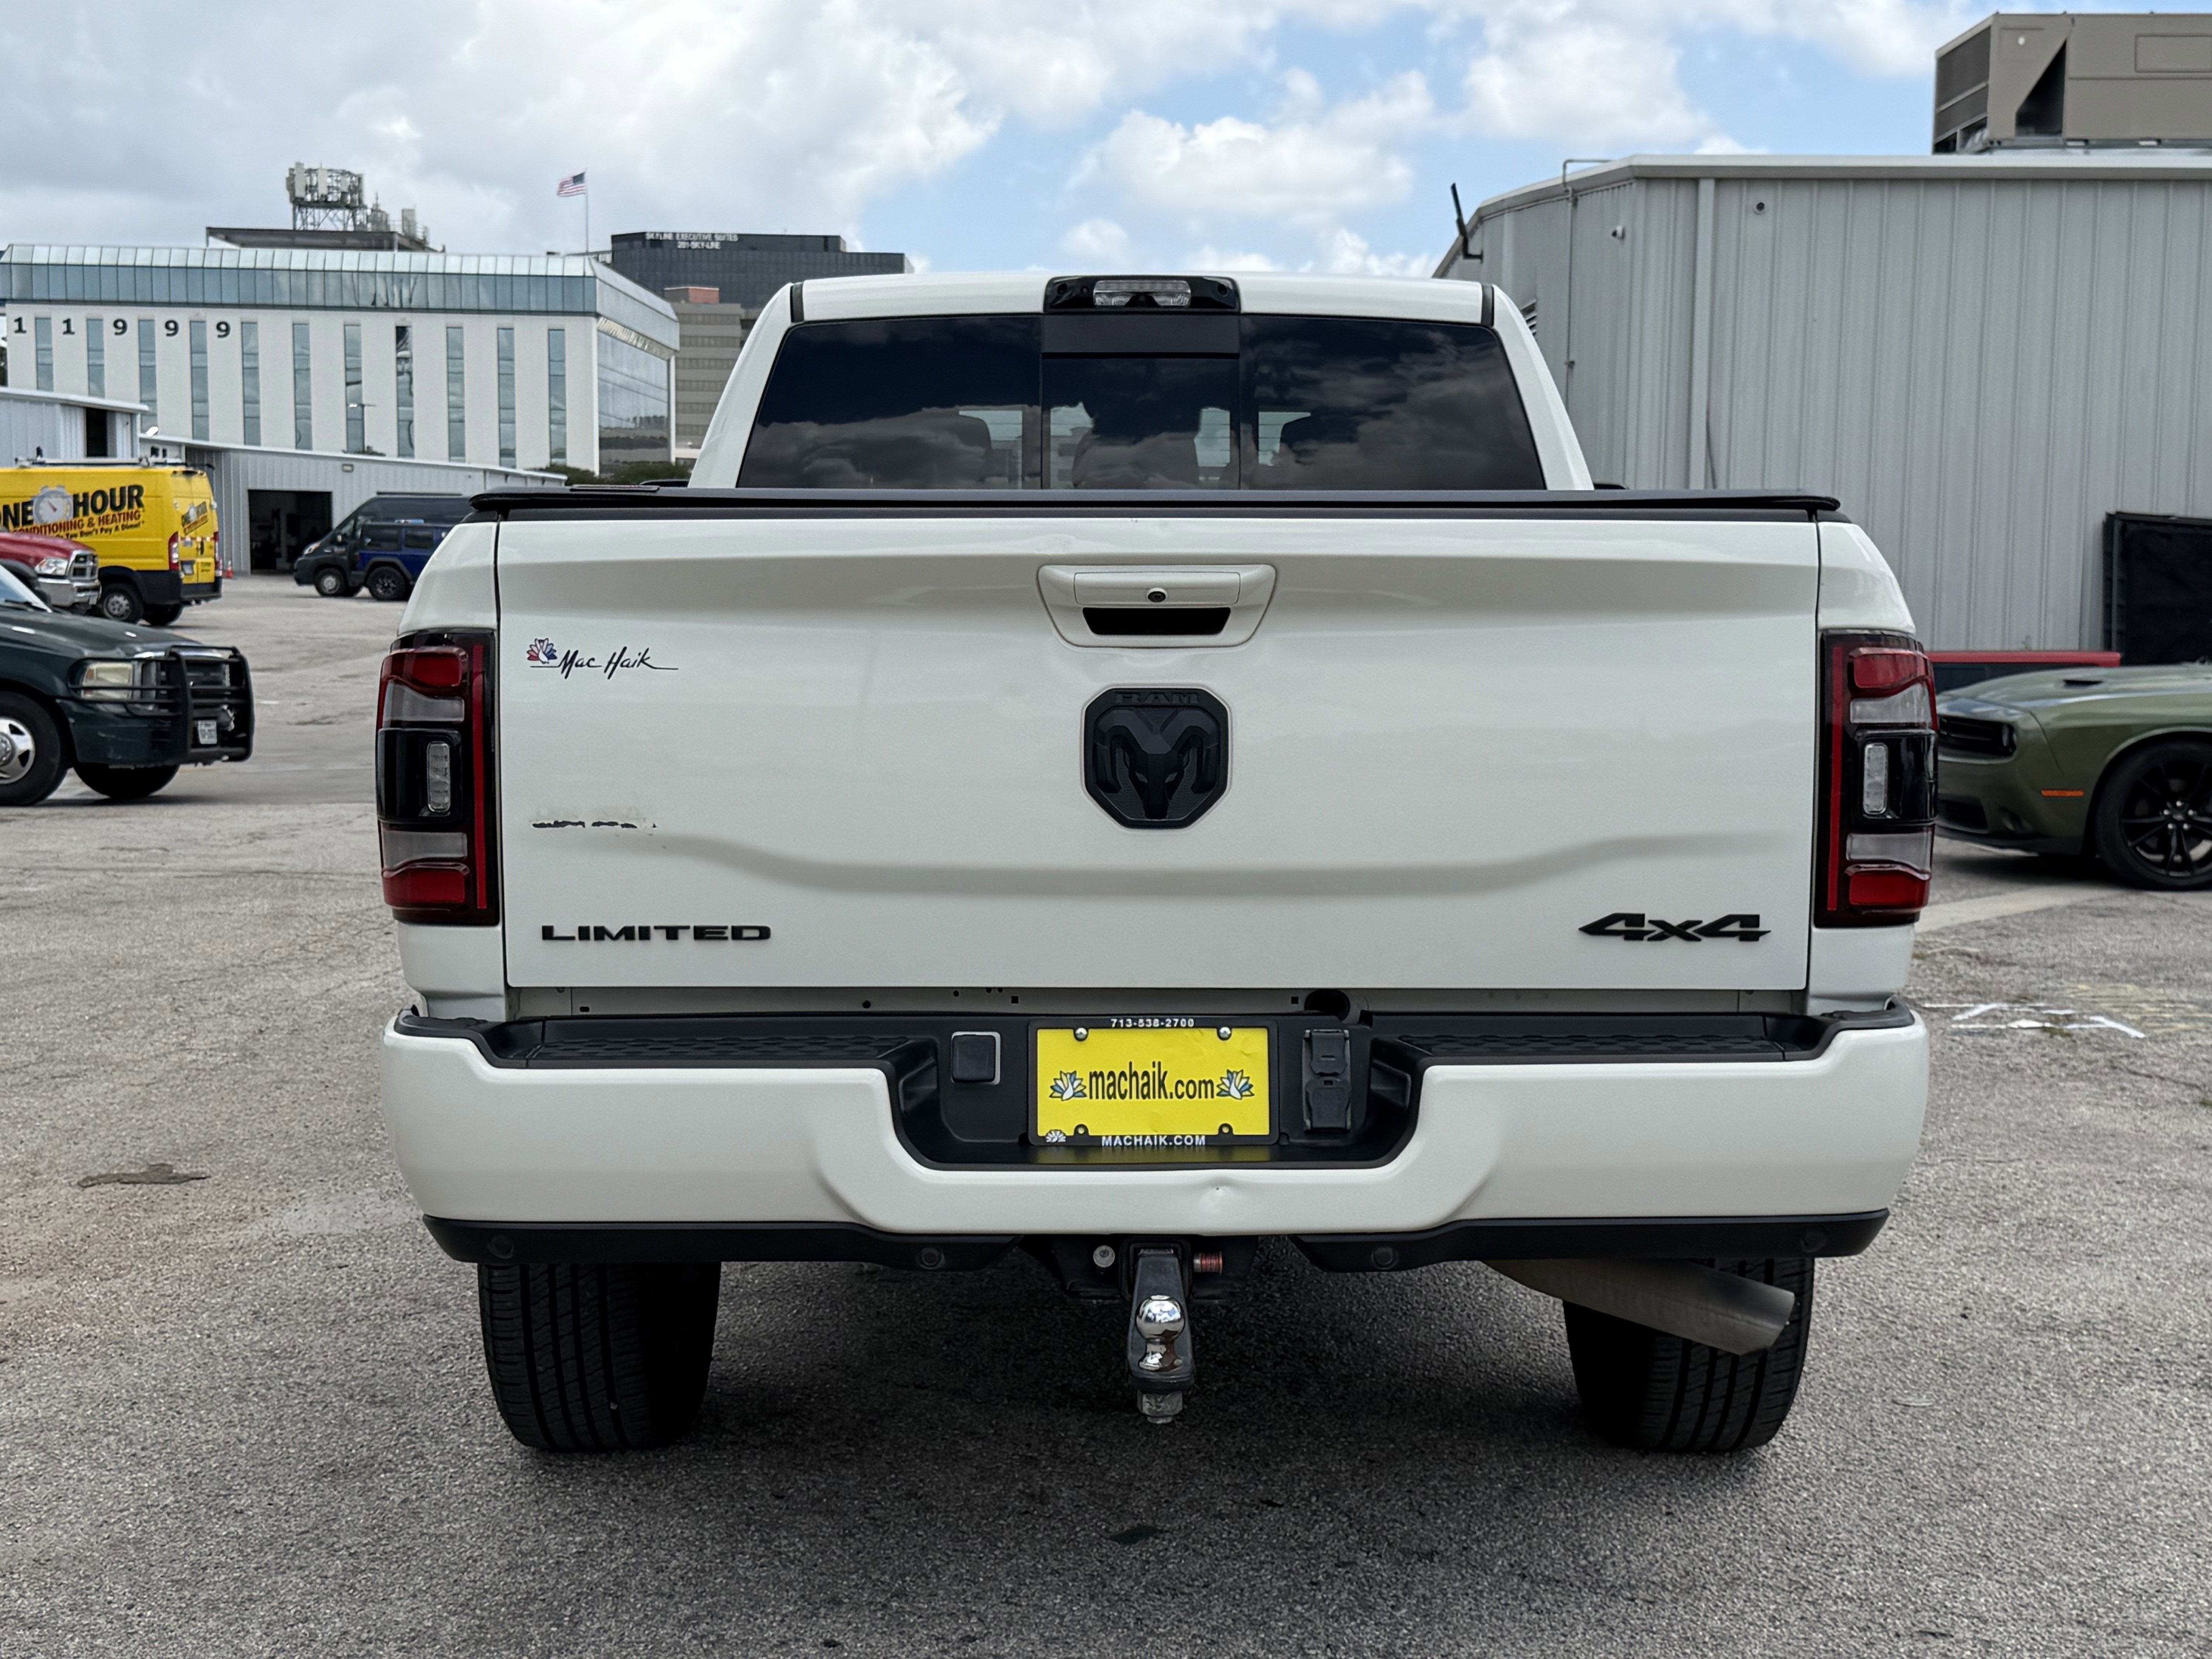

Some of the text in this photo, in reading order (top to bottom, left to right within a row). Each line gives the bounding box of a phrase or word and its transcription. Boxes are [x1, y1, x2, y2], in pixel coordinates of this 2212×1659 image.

[0, 484, 144, 531] NE HOUR
[88, 517, 94, 527] &
[98, 510, 141, 526] HEATING
[550, 646, 678, 680] Mac Haik
[1115, 692, 1199, 704] RAM
[542, 925, 771, 941] LIMITED
[1578, 912, 1772, 941] 4x4
[1110, 1018, 1195, 1028] 713-538-2700
[1089, 1061, 1215, 1100] machaik.com
[1101, 1135, 1206, 1146] MACHAIK.COM
